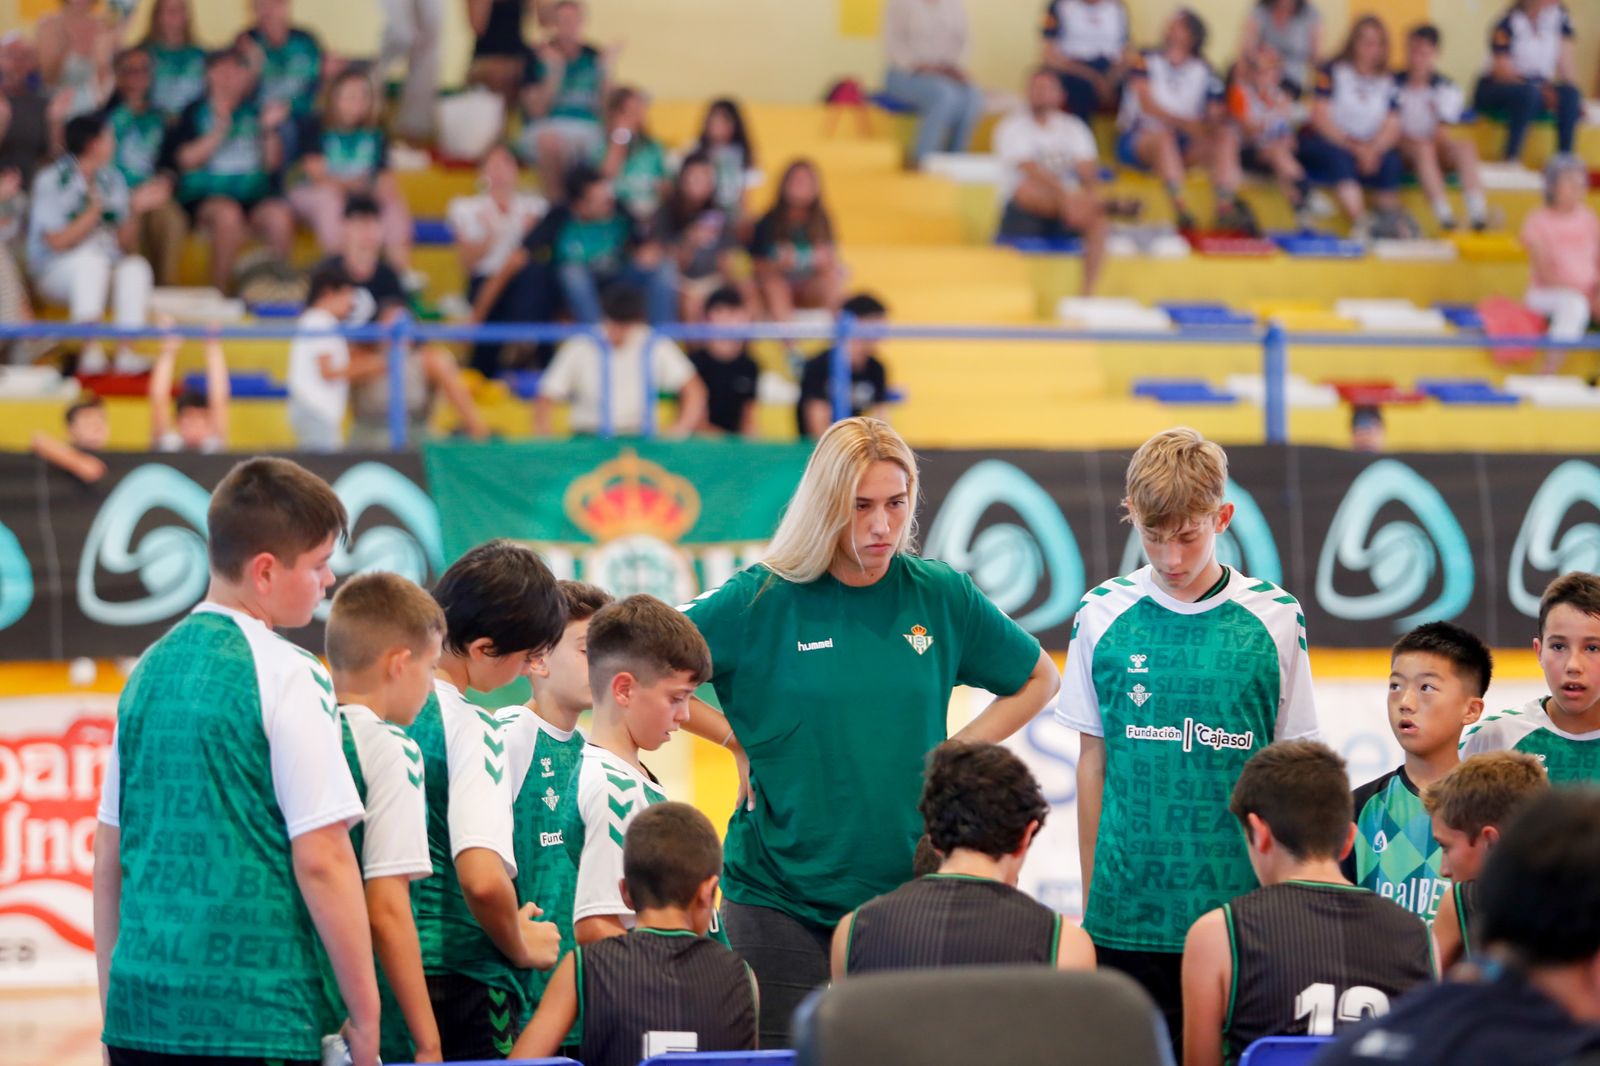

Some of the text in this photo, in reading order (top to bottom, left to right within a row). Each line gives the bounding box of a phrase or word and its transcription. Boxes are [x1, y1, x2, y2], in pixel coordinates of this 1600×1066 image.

[797, 637, 834, 652] hummel
[1128, 727, 1251, 748] Fundación Cajasol
[1141, 860, 1241, 892] REAL
